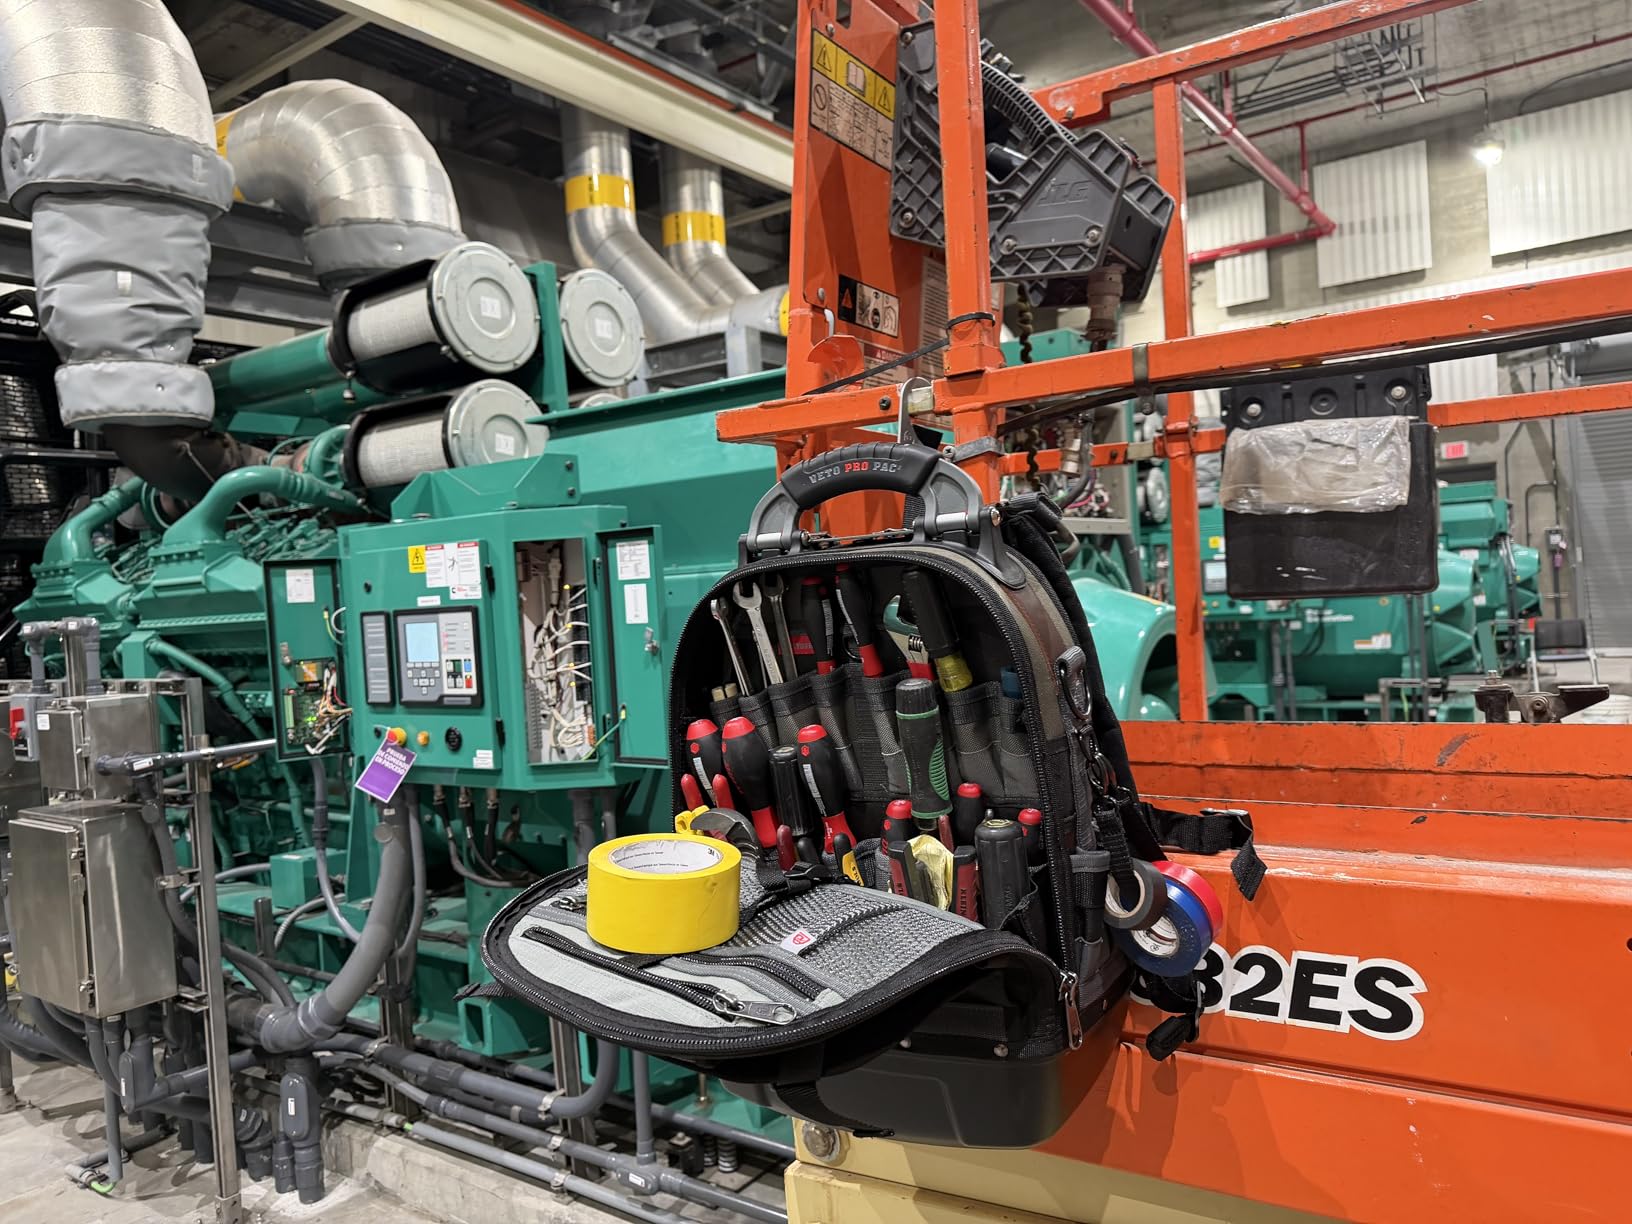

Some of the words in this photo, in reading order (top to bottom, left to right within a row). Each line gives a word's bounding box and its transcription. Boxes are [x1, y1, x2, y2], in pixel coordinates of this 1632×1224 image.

[809, 466, 841, 484] VETO
[844, 461, 869, 473] PRO
[386, 747, 407, 762] PRUEBA
[1130, 949, 1415, 1034] 32ES
